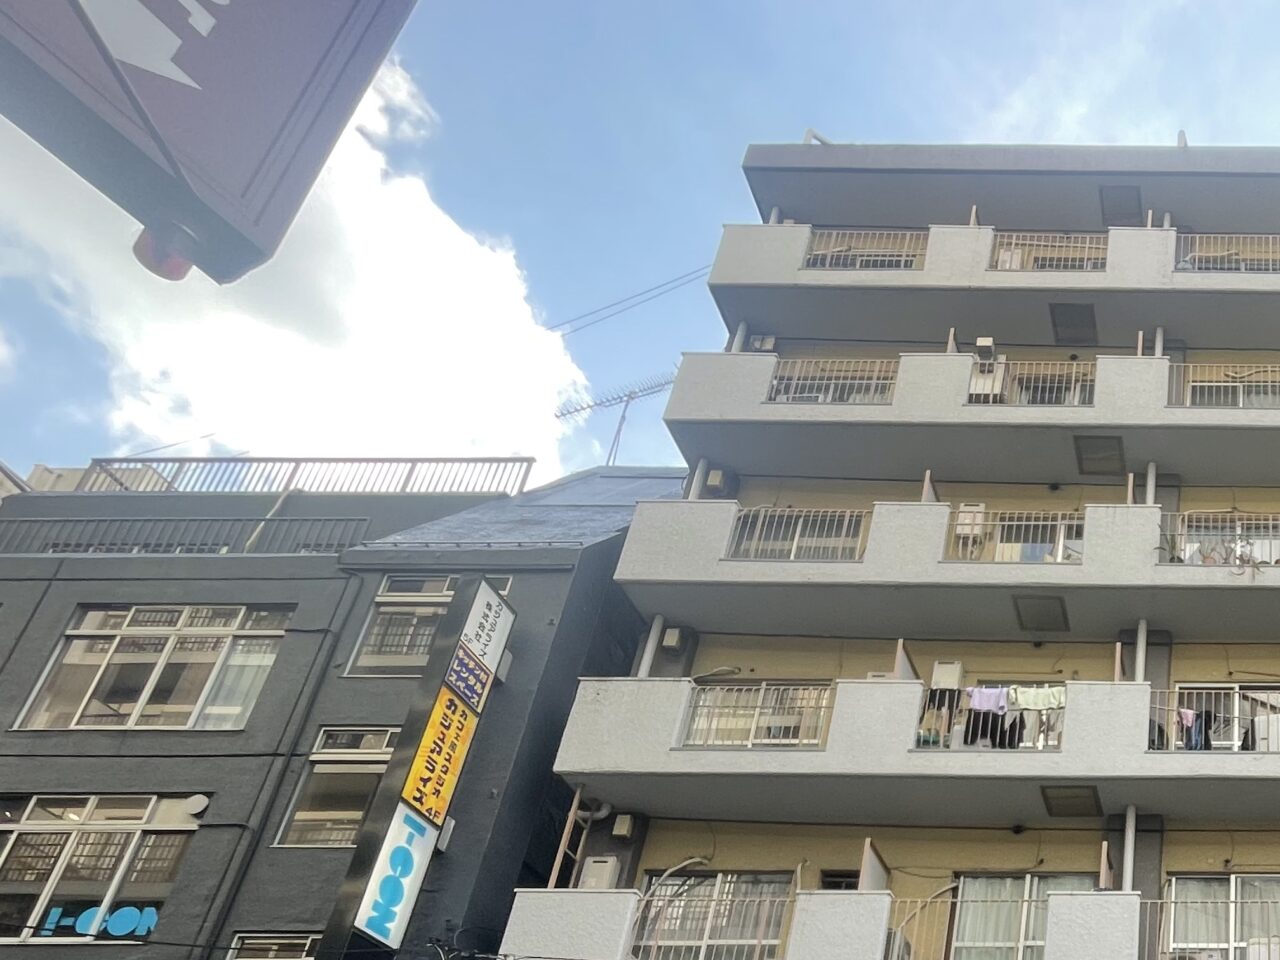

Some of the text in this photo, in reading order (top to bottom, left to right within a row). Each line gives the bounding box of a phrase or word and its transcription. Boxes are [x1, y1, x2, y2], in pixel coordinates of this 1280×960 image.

[449, 672, 479, 705] スペース
[453, 660, 483, 693] レンタル
[424, 806, 442, 821] 4F
